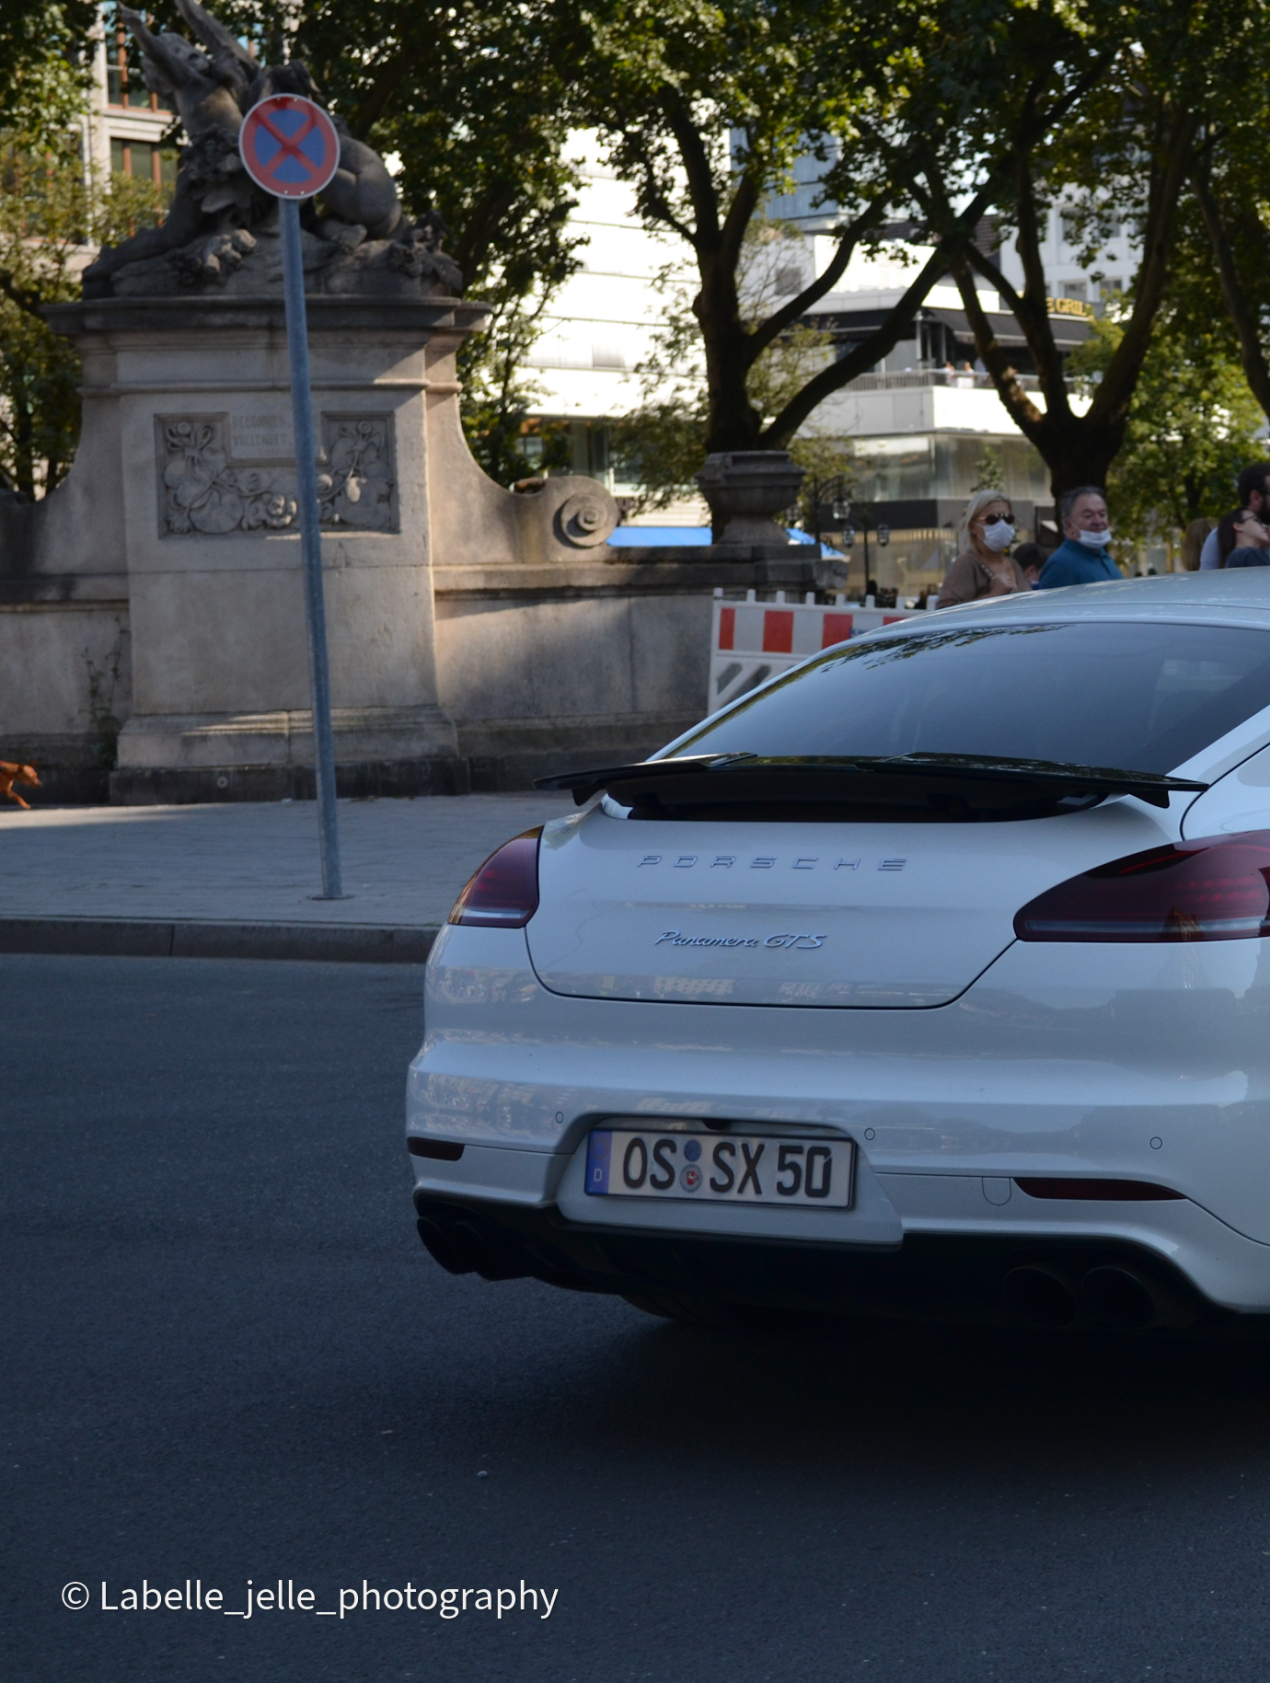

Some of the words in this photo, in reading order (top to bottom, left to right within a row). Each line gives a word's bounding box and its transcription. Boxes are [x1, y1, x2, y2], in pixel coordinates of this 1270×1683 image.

[637, 855, 907, 871] PORSCHE
[654, 930, 758, 948] Panamera
[763, 934, 827, 949] GTS
[593, 1168, 602, 1182] D
[623, 1138, 677, 1190] OS
[709, 1142, 765, 1195] SX
[776, 1145, 832, 1198] 50
